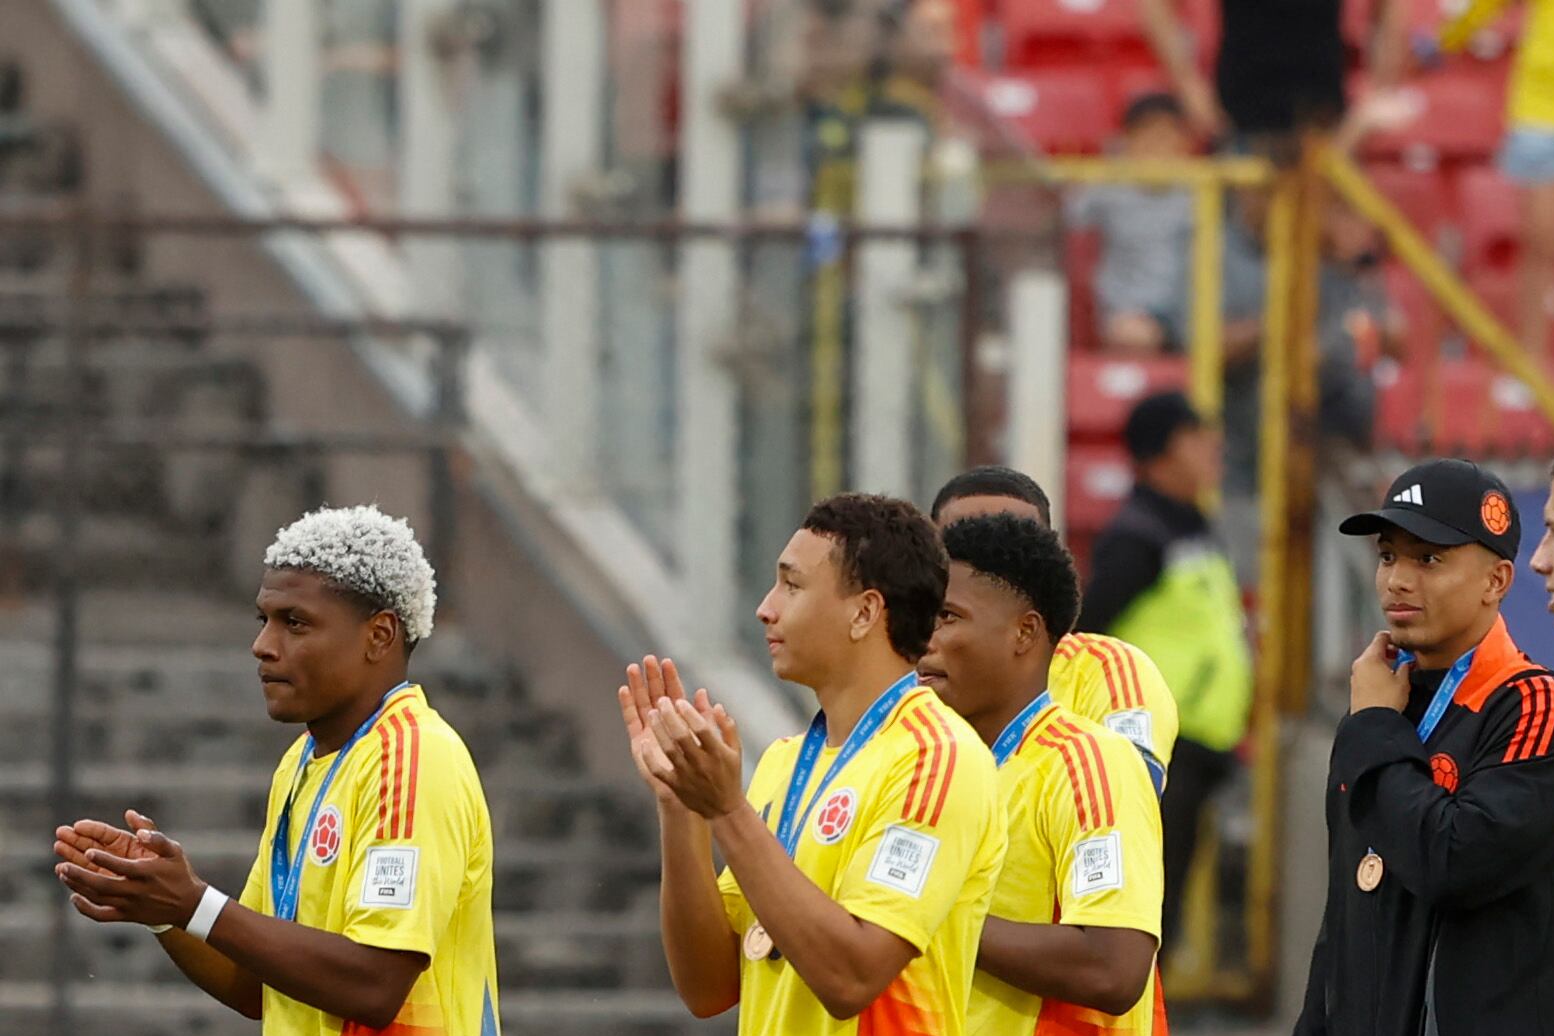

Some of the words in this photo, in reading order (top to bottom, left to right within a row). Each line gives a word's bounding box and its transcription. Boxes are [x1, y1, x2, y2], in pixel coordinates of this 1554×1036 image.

[376, 855, 405, 866] FOOTBALL
[889, 845, 922, 864] UNITES
[374, 865, 405, 877] UNITES
